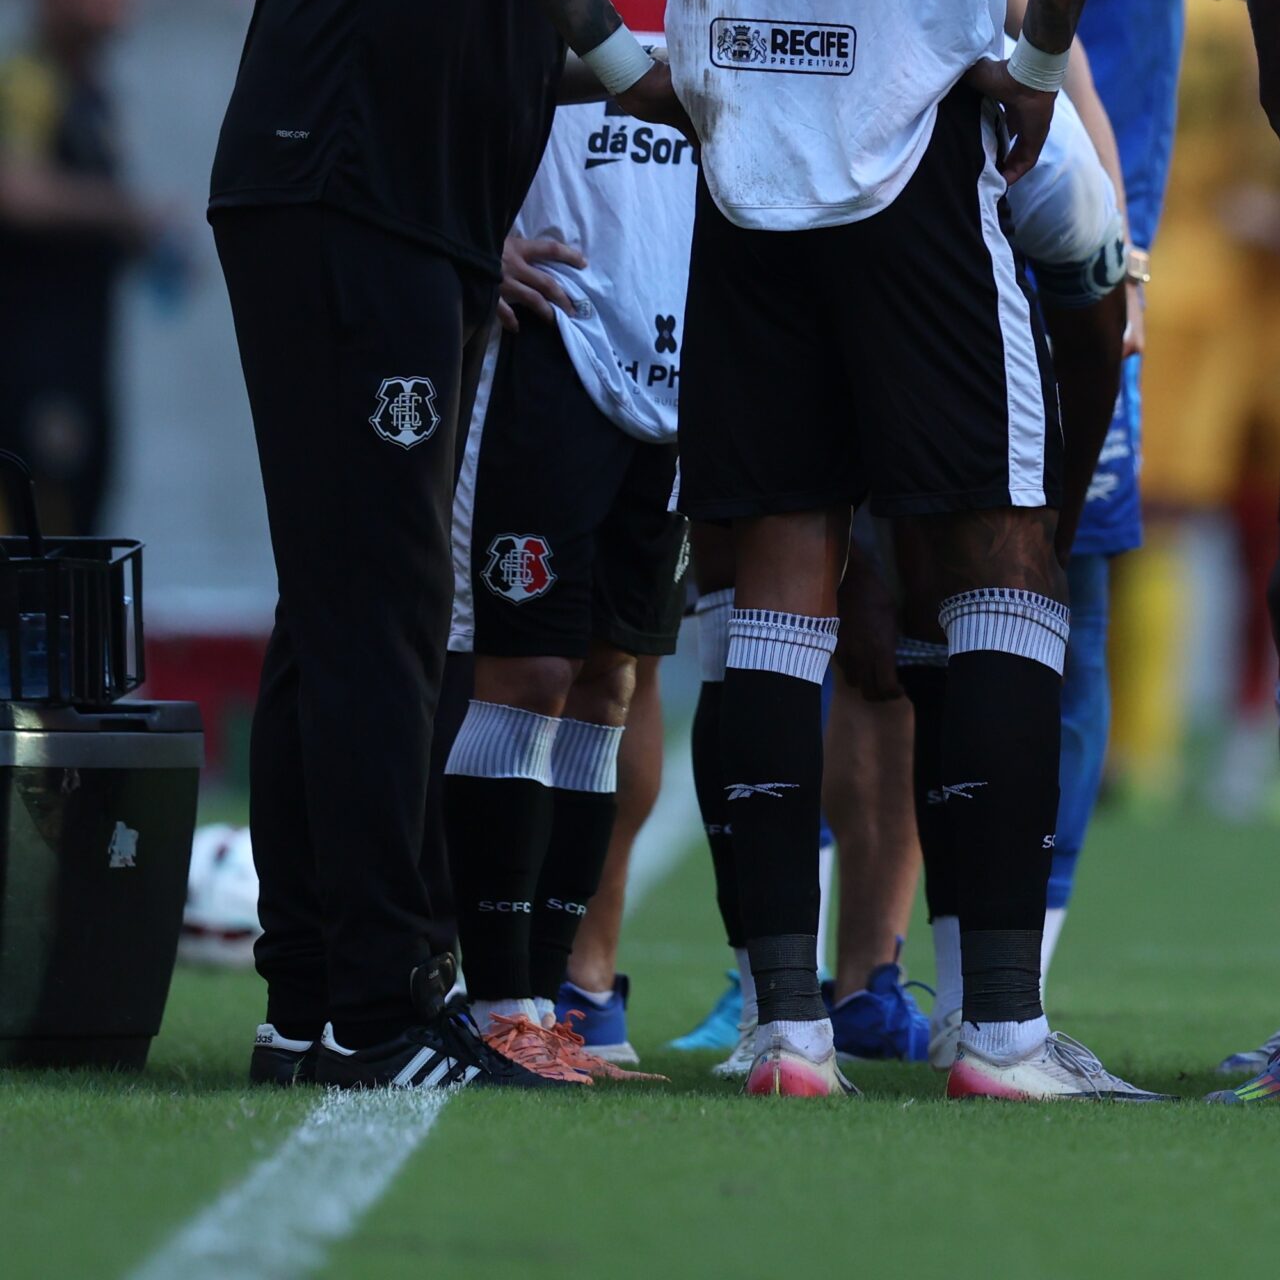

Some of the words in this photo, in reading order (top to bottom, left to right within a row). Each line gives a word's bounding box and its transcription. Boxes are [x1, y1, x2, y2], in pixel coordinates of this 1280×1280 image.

[771, 28, 849, 58] RECIFE
[770, 57, 849, 68] PREFEITURA
[479, 900, 532, 913] SCFC
